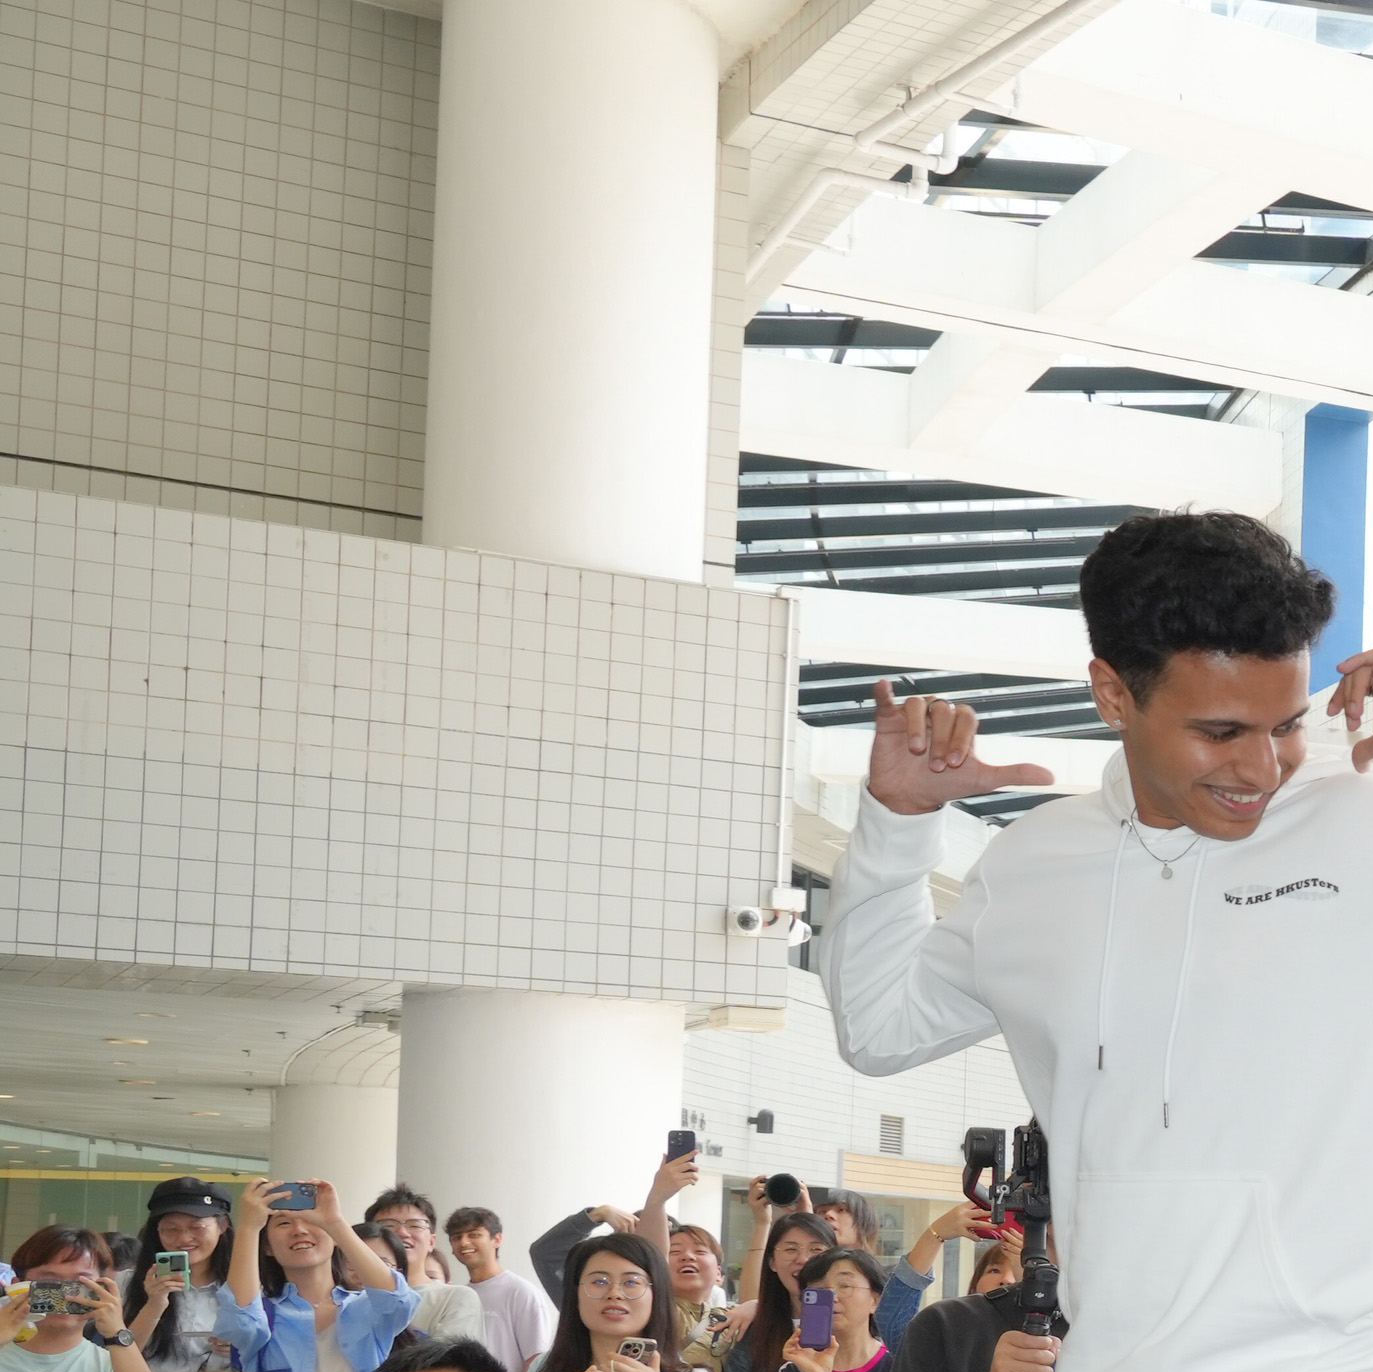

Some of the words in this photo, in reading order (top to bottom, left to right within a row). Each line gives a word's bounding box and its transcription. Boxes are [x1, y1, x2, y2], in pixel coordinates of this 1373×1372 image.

[1224, 892, 1242, 905] WE
[1245, 892, 1272, 905] ARE
[1275, 878, 1339, 897] HKUSTers
